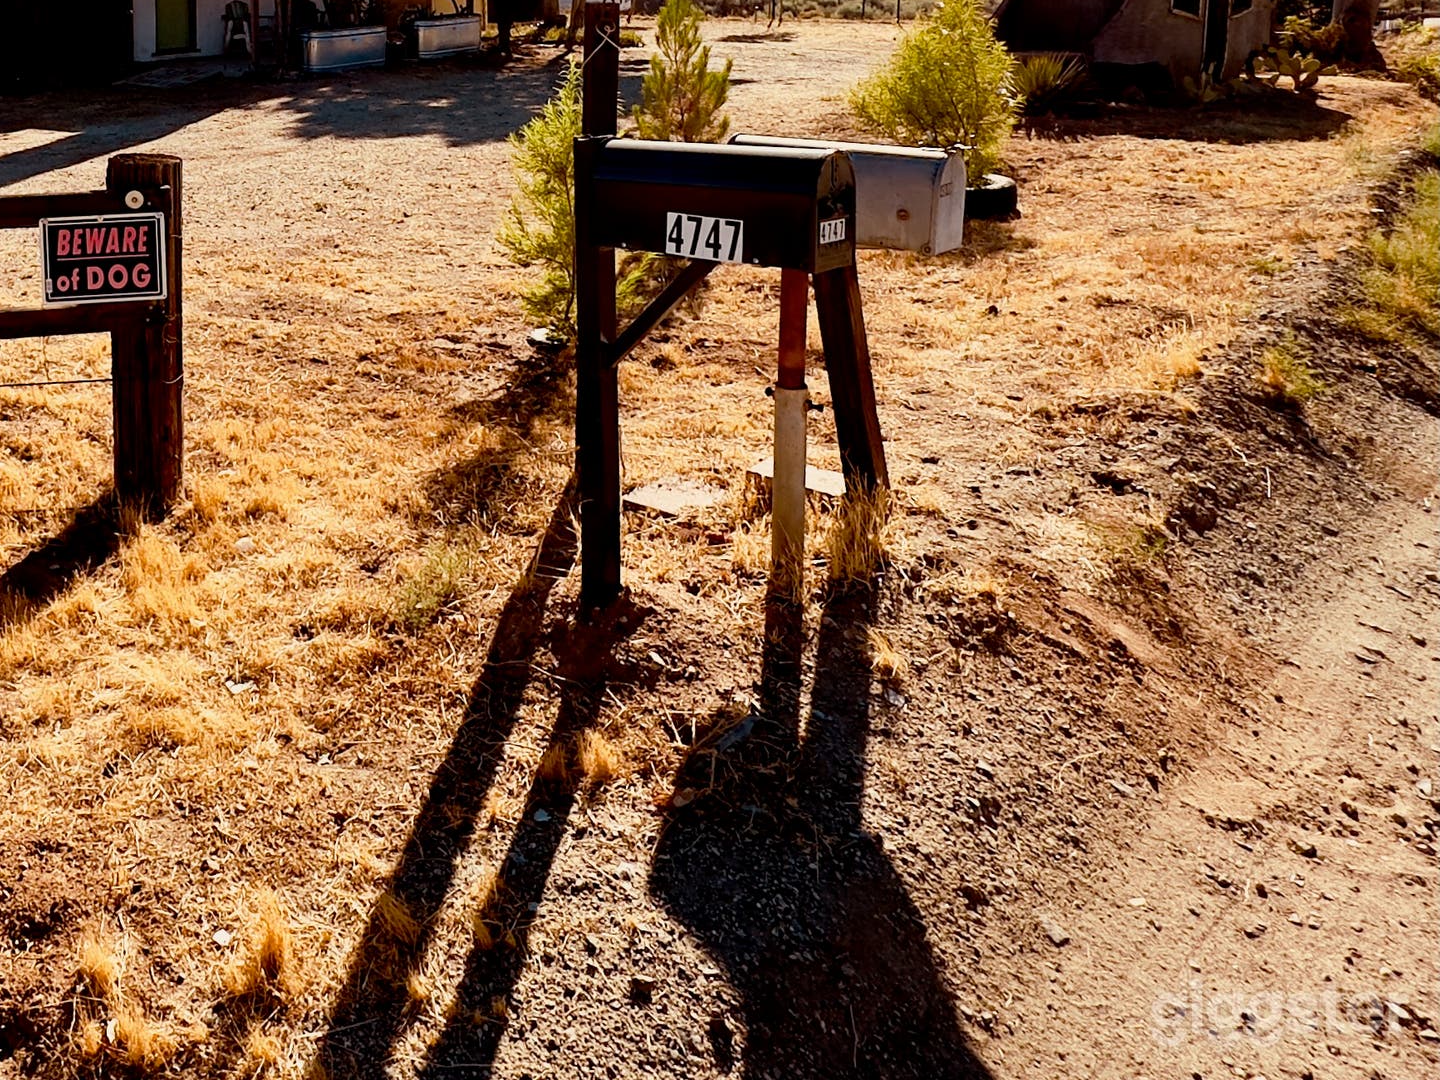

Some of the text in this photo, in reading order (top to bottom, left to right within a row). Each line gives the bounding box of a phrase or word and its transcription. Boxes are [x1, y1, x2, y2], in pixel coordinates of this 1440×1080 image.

[56, 225, 149, 256] BEWARE
[668, 214, 741, 260] 4747
[821, 220, 844, 242] 4747
[56, 262, 152, 292] of DOG
